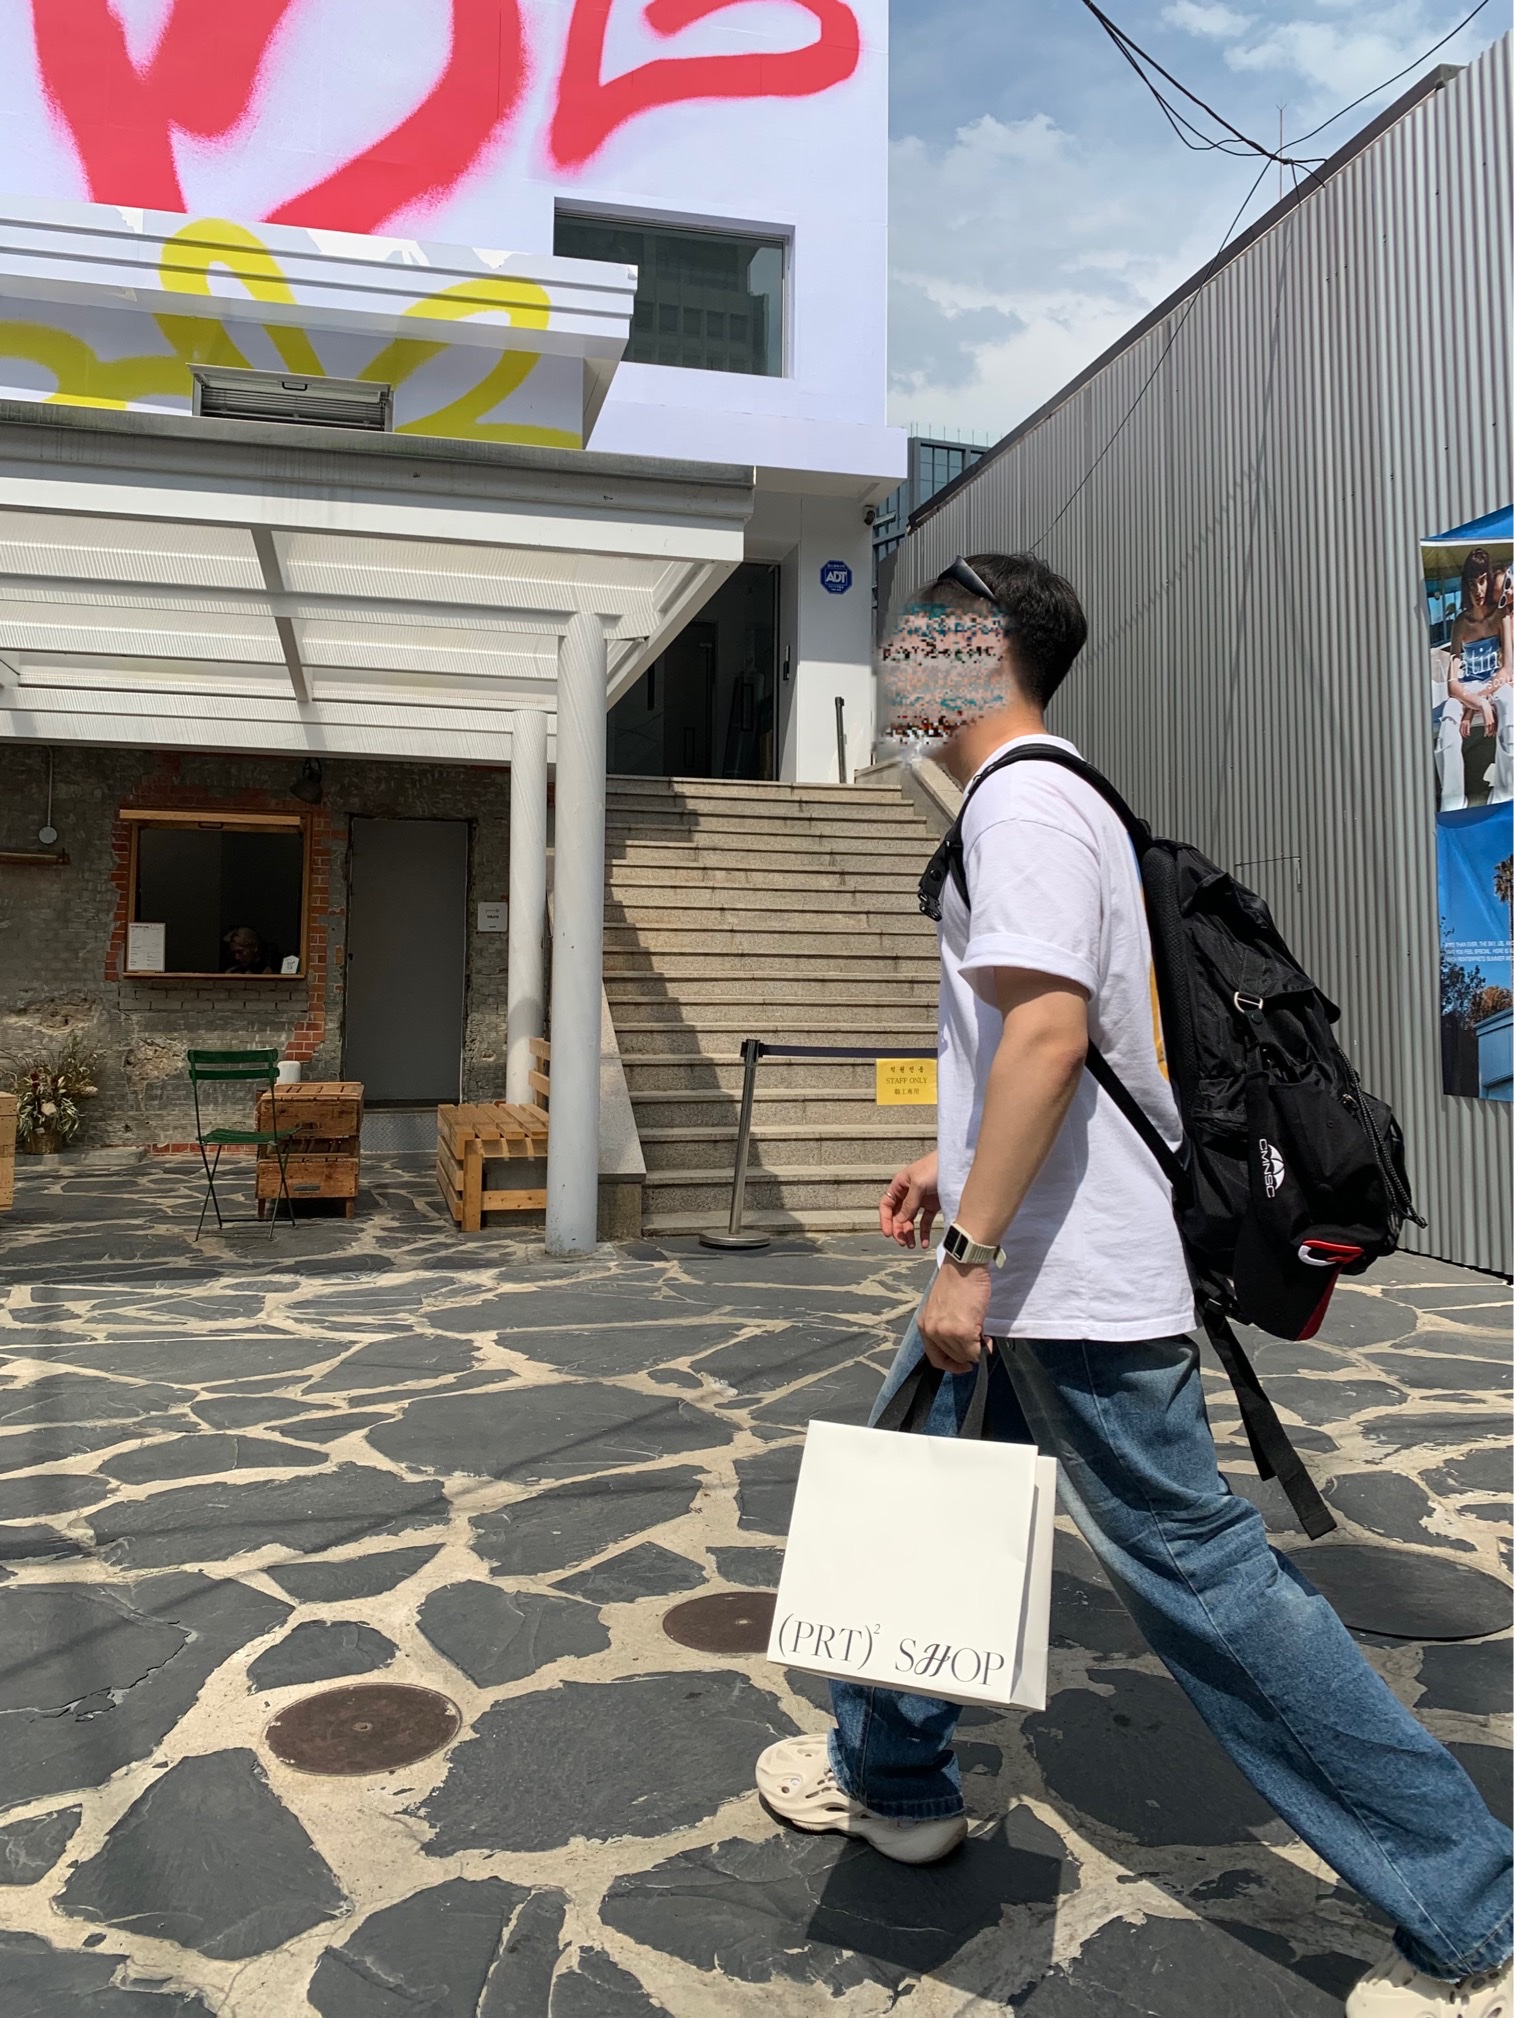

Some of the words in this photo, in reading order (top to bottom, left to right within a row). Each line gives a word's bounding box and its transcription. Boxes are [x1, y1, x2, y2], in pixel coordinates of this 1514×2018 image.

[825, 570, 847, 583] ADT
[1259, 1138, 1276, 1198] CMNSC
[895, 1638, 1005, 1686] SHOP
